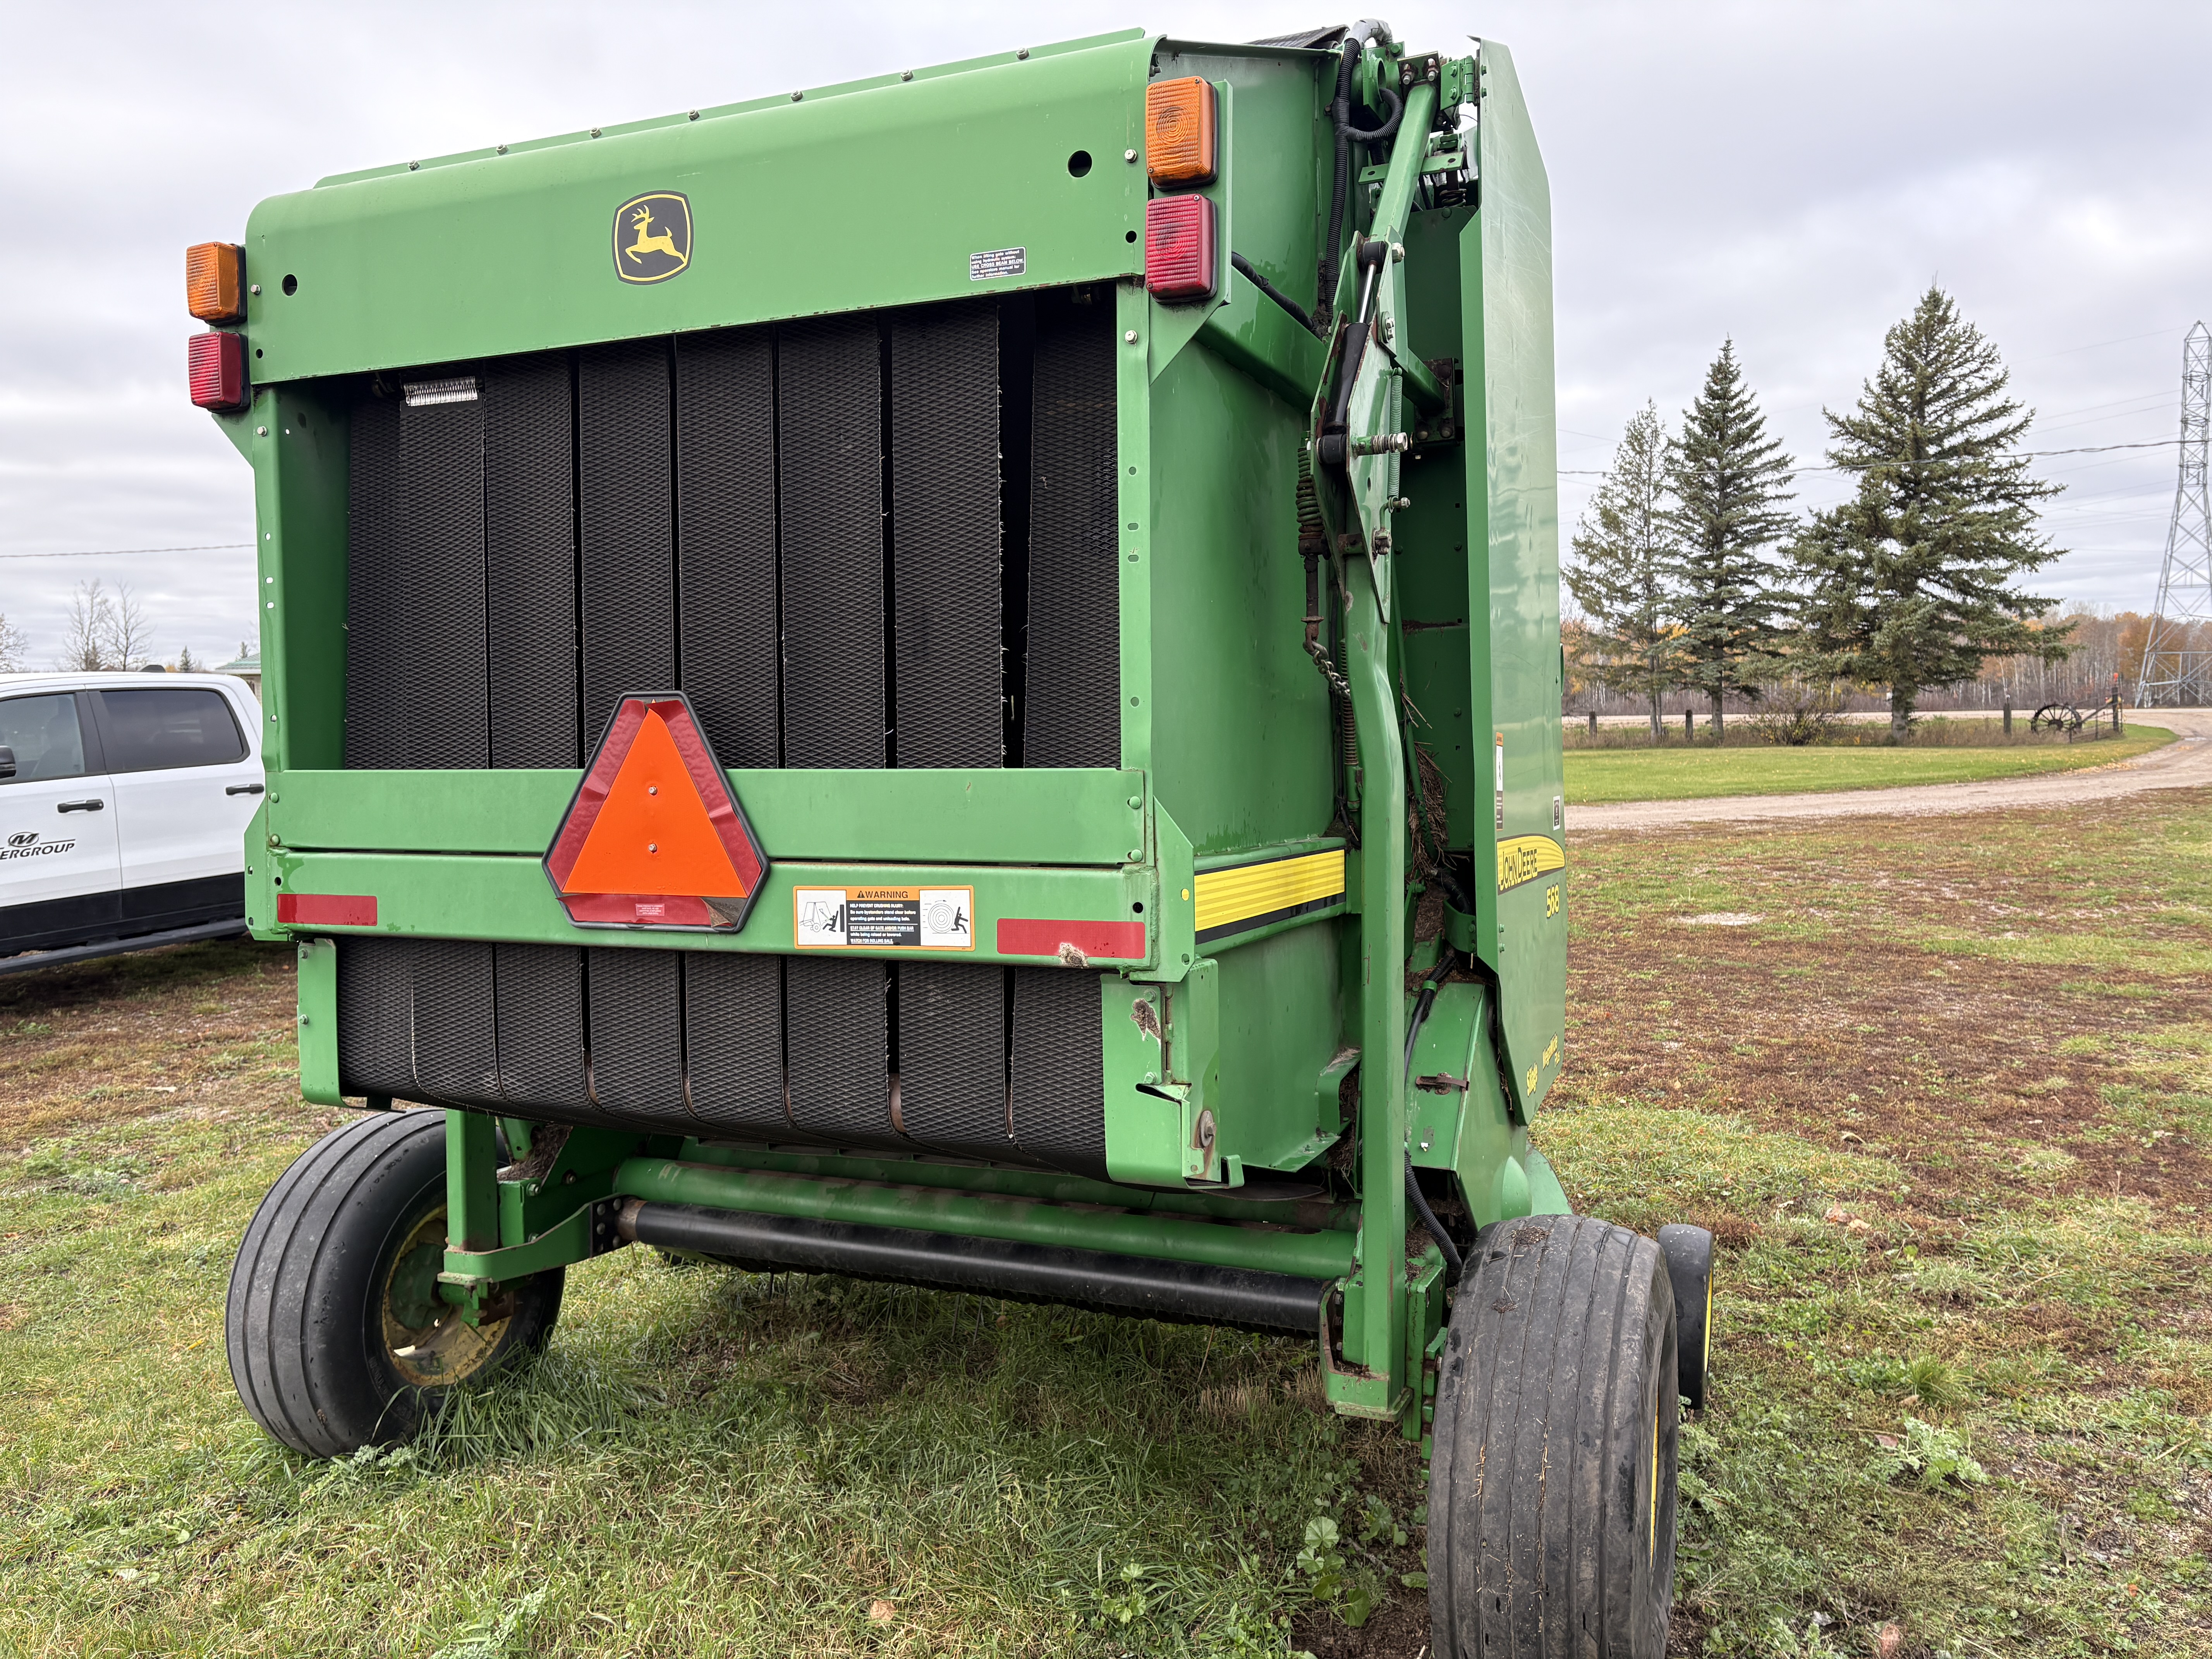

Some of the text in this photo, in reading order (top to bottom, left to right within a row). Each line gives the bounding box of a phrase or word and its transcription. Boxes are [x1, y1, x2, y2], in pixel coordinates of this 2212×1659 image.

[1500, 847, 1538, 889] JOHN DEERE
[1547, 883, 1559, 919] 568
[1527, 1062, 1538, 1097] Silage
